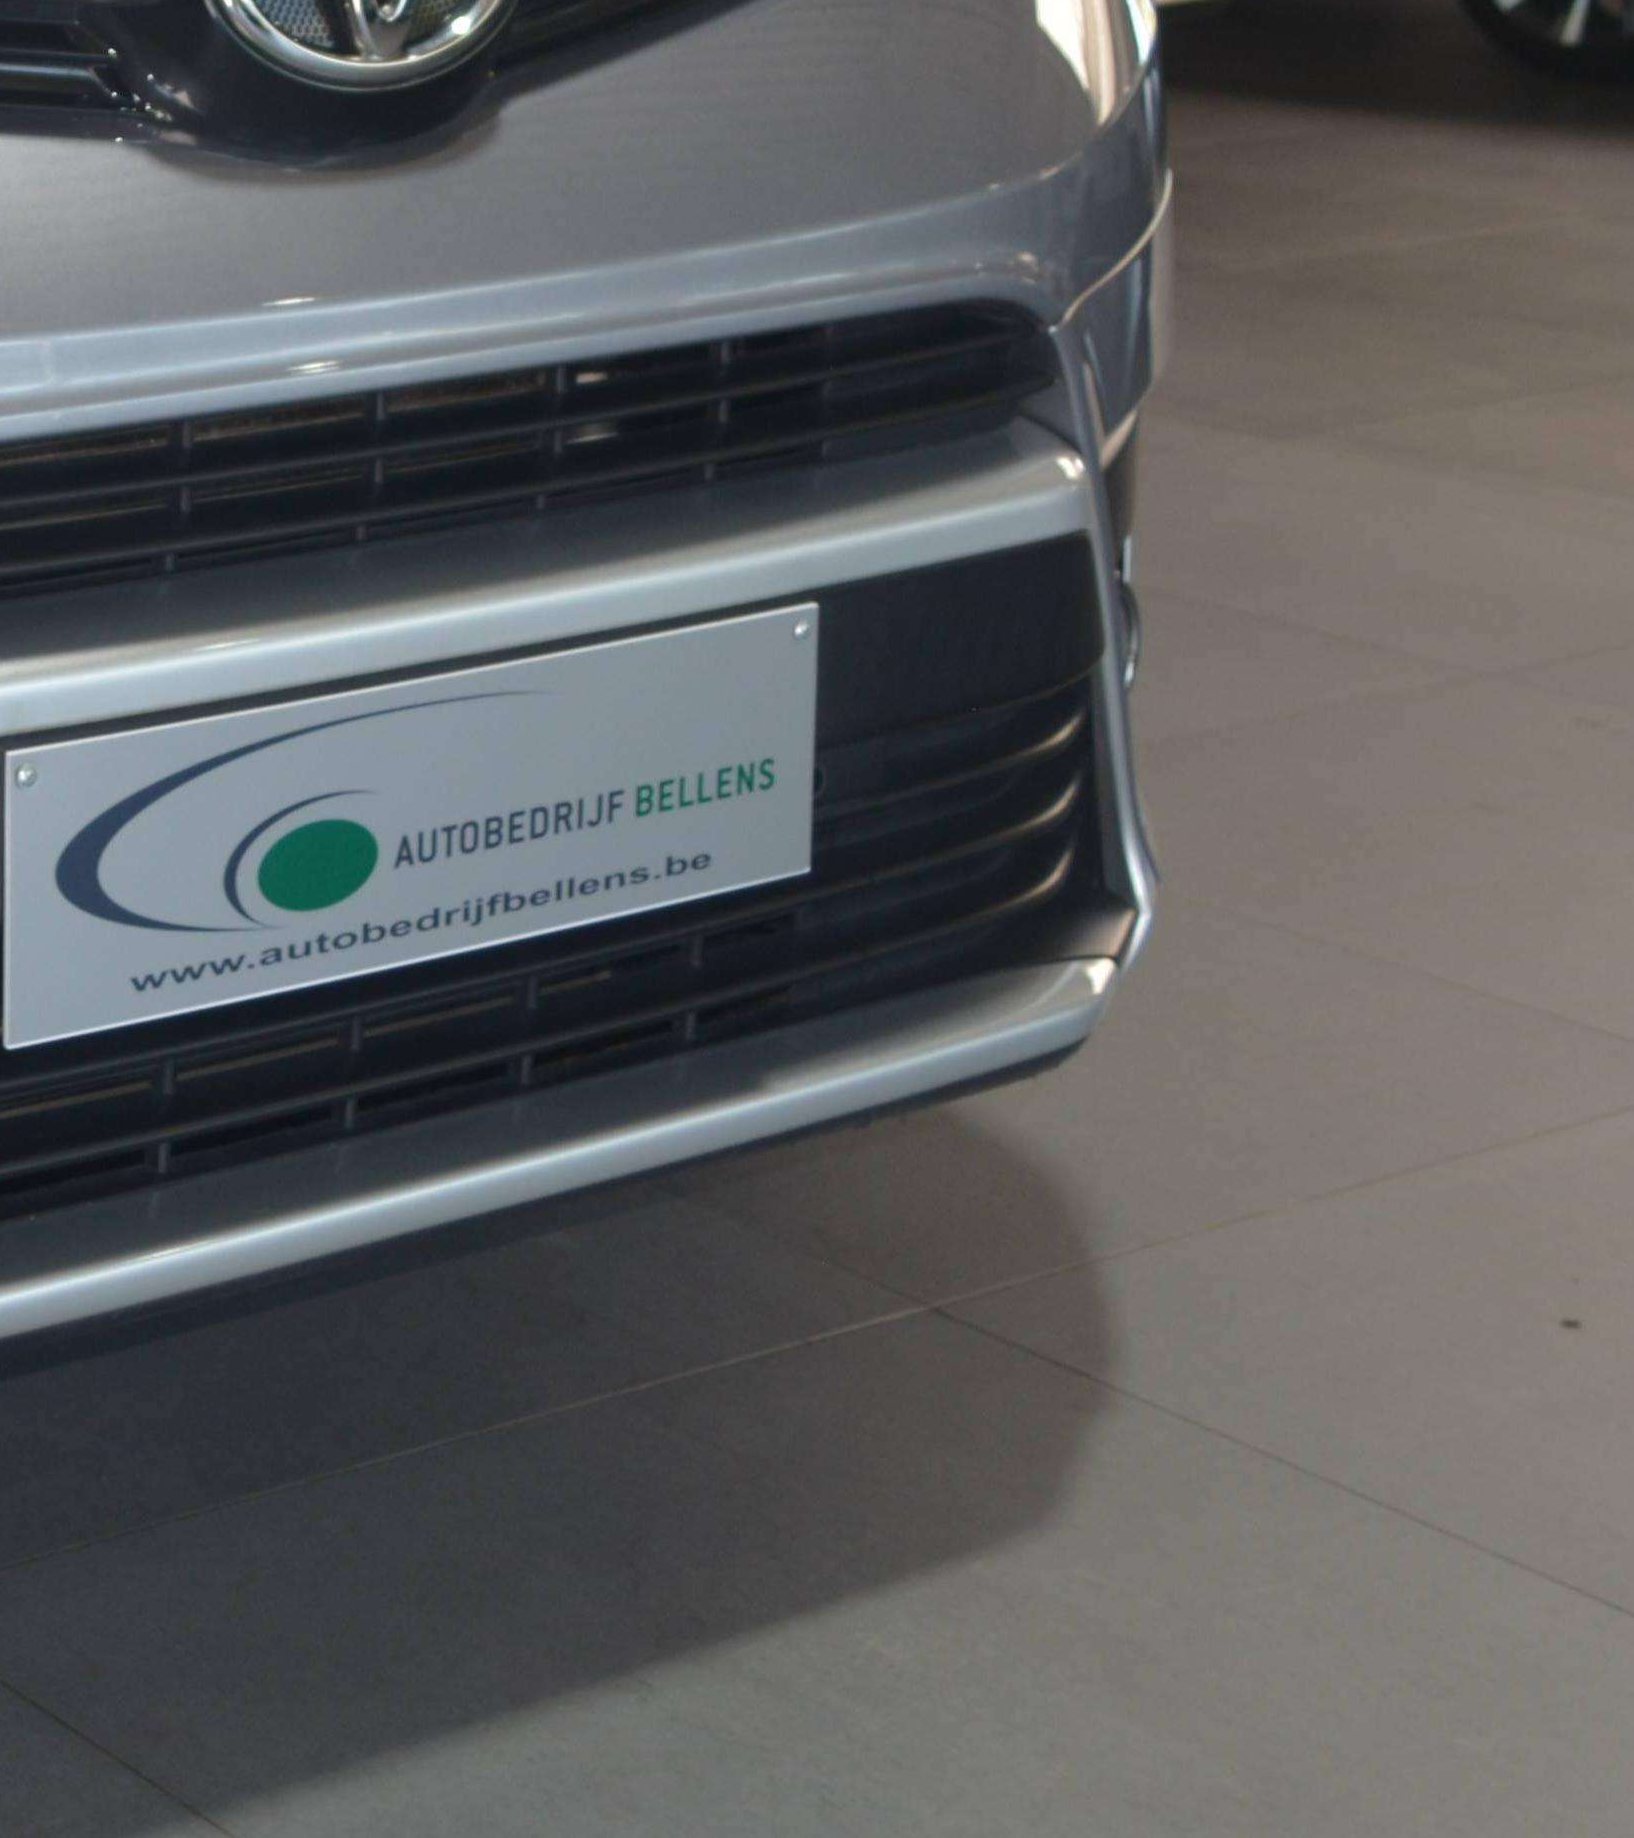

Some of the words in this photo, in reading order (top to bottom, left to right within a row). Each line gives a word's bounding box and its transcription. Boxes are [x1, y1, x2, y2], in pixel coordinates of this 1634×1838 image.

[393, 789, 626, 869] AUTOBEDRIJF
[635, 758, 777, 818] BELLENS
[129, 850, 713, 992] www.autobedrijfbellens.be
